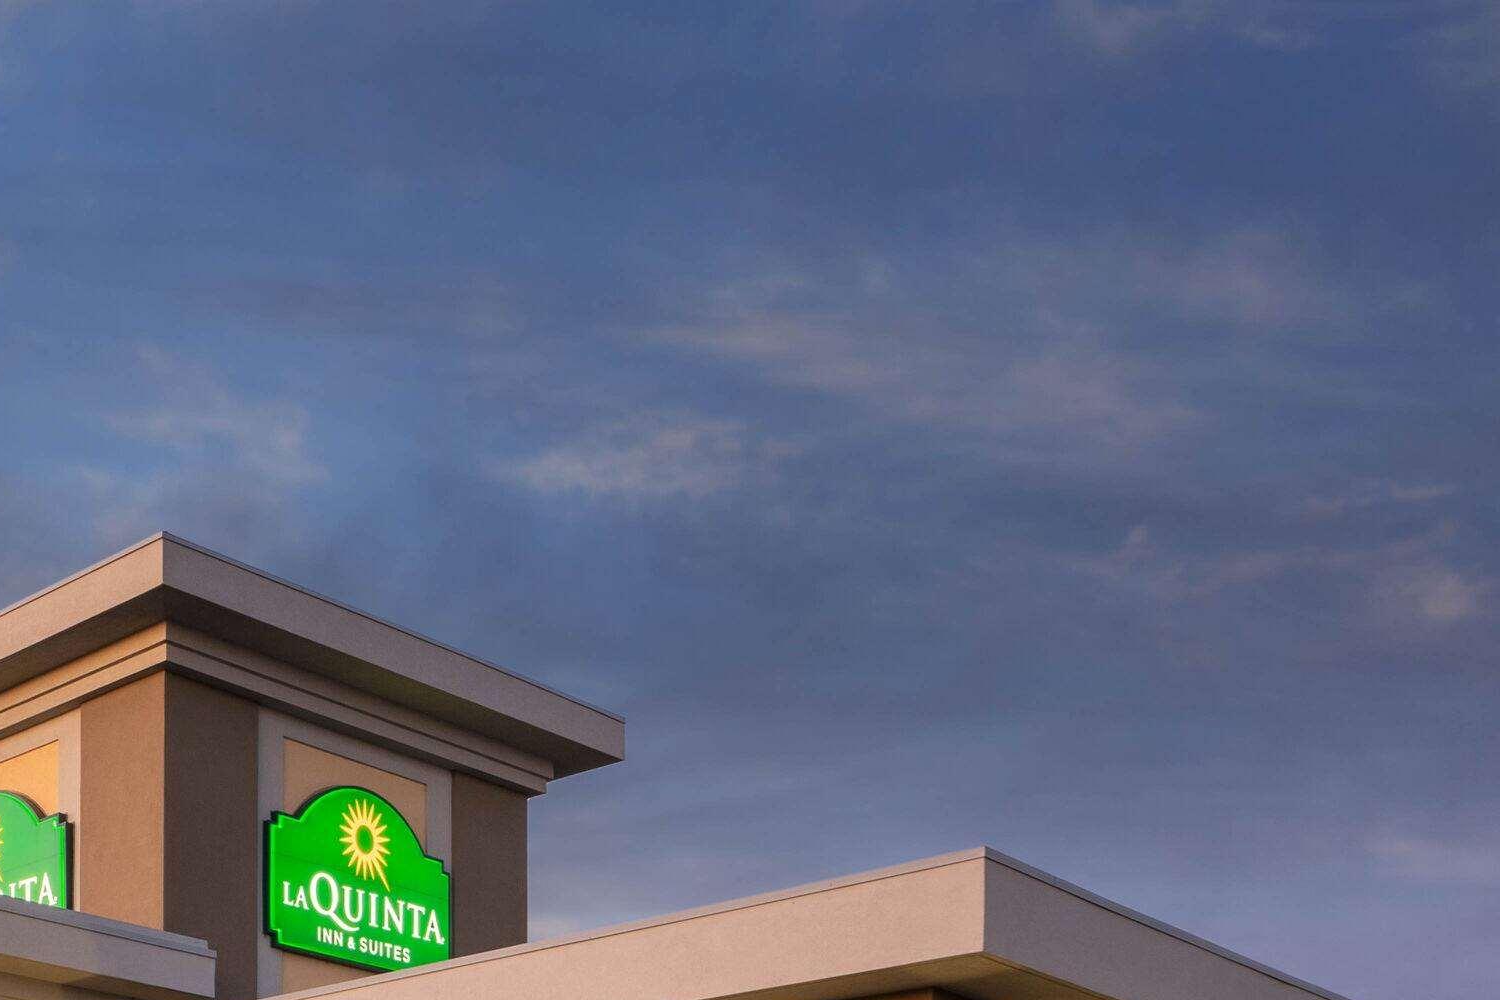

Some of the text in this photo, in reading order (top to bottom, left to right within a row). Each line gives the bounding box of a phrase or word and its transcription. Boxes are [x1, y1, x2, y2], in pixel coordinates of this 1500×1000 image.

[309, 872, 445, 945] QUINTA
[317, 926, 411, 963] INN & SUITES
